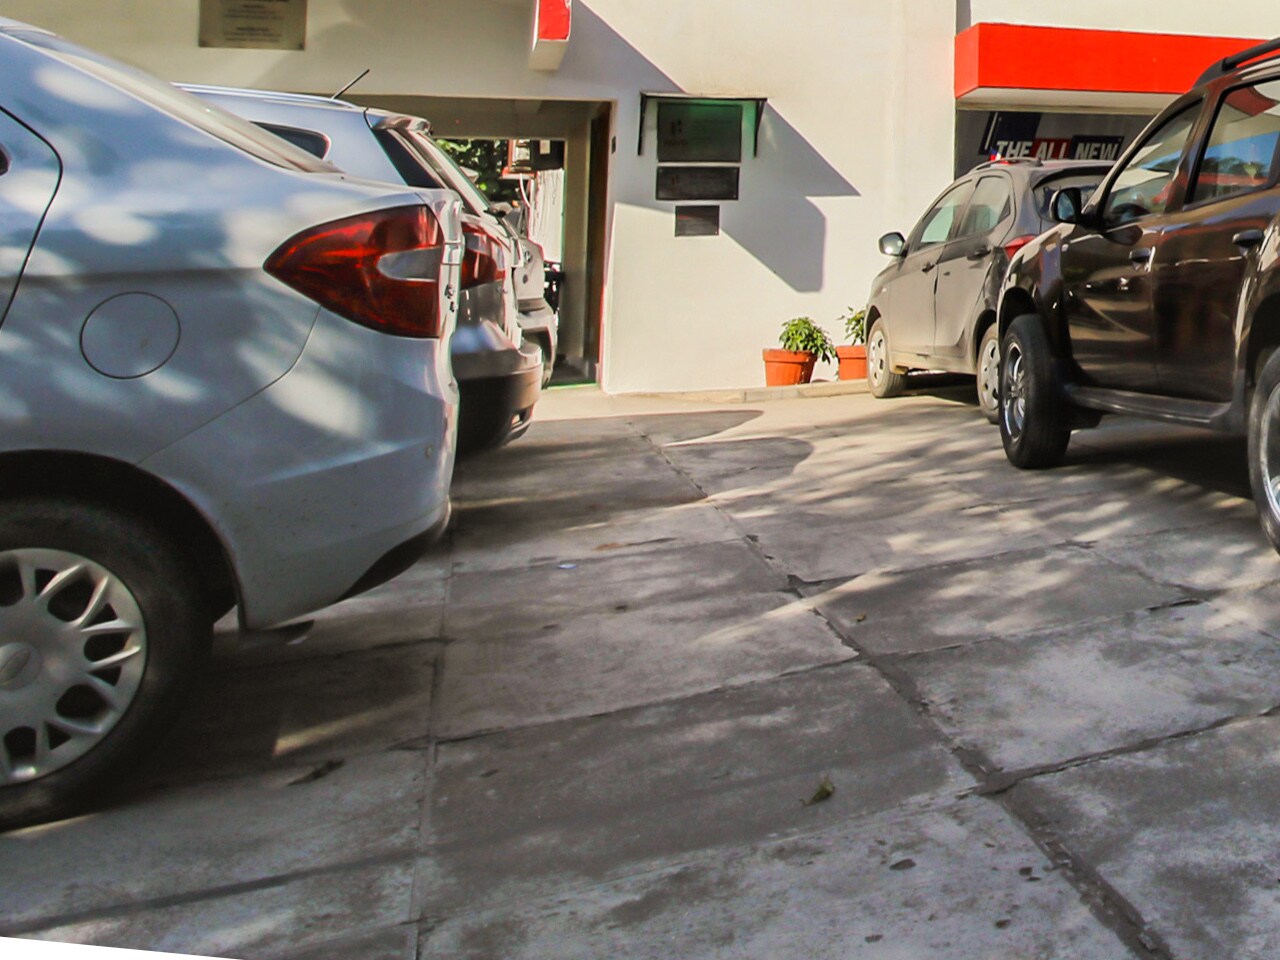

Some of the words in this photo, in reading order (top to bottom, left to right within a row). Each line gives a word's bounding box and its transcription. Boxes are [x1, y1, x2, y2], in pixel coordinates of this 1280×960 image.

[997, 141, 1032, 159] THE
[1035, 142, 1068, 160] ALL
[1075, 142, 1119, 160] NEW
